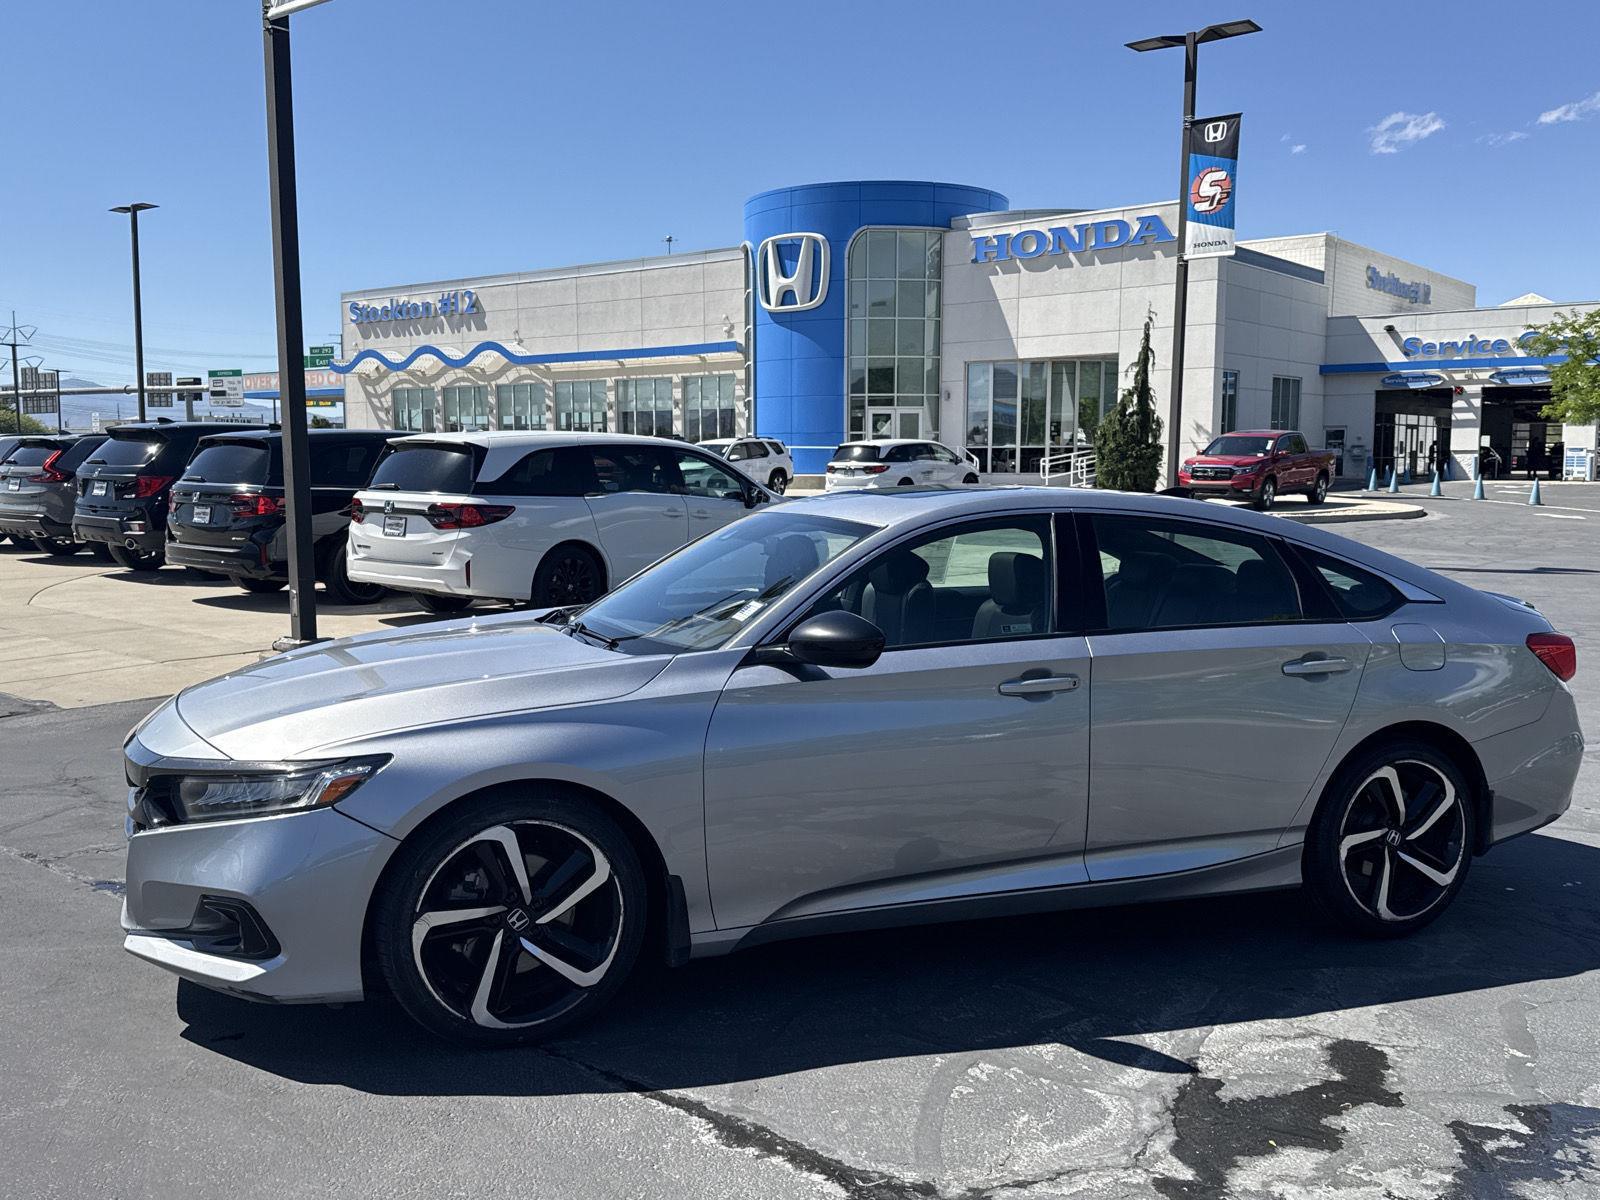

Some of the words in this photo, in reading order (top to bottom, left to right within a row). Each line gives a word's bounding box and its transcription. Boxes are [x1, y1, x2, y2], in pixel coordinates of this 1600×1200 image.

[971, 215, 1176, 263] HONDA
[1193, 240, 1228, 249] HONDA
[349, 298, 433, 324] Stockton
[439, 290, 475, 315] #12
[1403, 334, 1509, 356] Service
[244, 375, 272, 389] OVER
